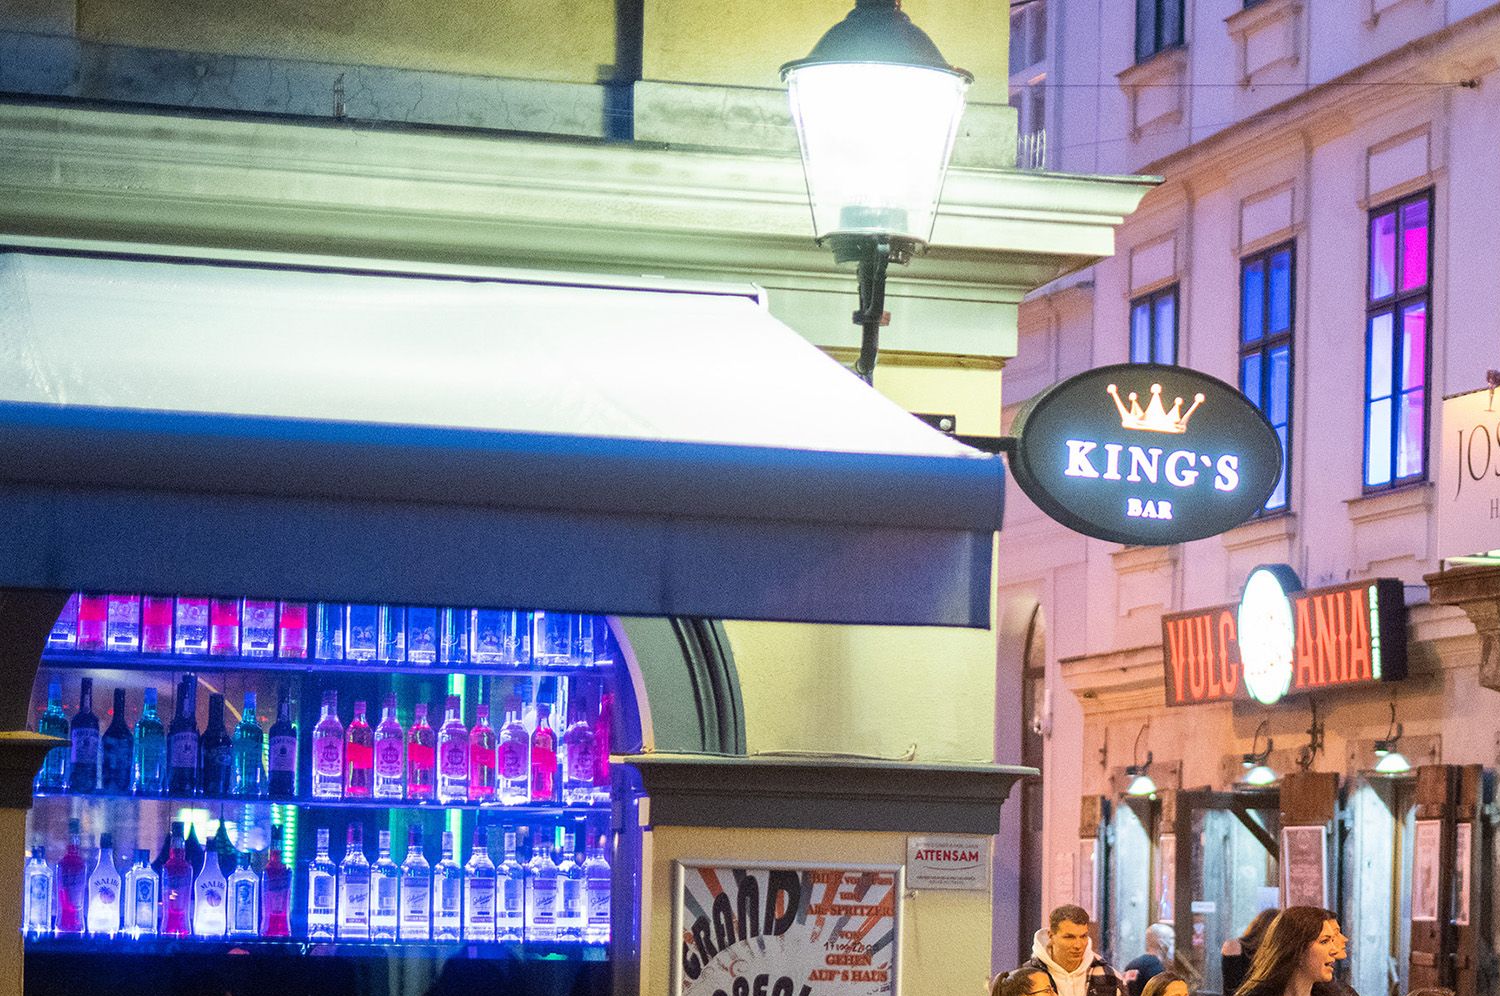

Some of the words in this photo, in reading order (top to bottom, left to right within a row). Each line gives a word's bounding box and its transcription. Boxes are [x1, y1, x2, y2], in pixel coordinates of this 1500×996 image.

[1127, 499, 1172, 520] BAR
[915, 849, 979, 862] ATTENSAM
[682, 870, 800, 980] GRAND
[826, 954, 872, 966] GEHEN
[851, 970, 888, 982] HAUS
